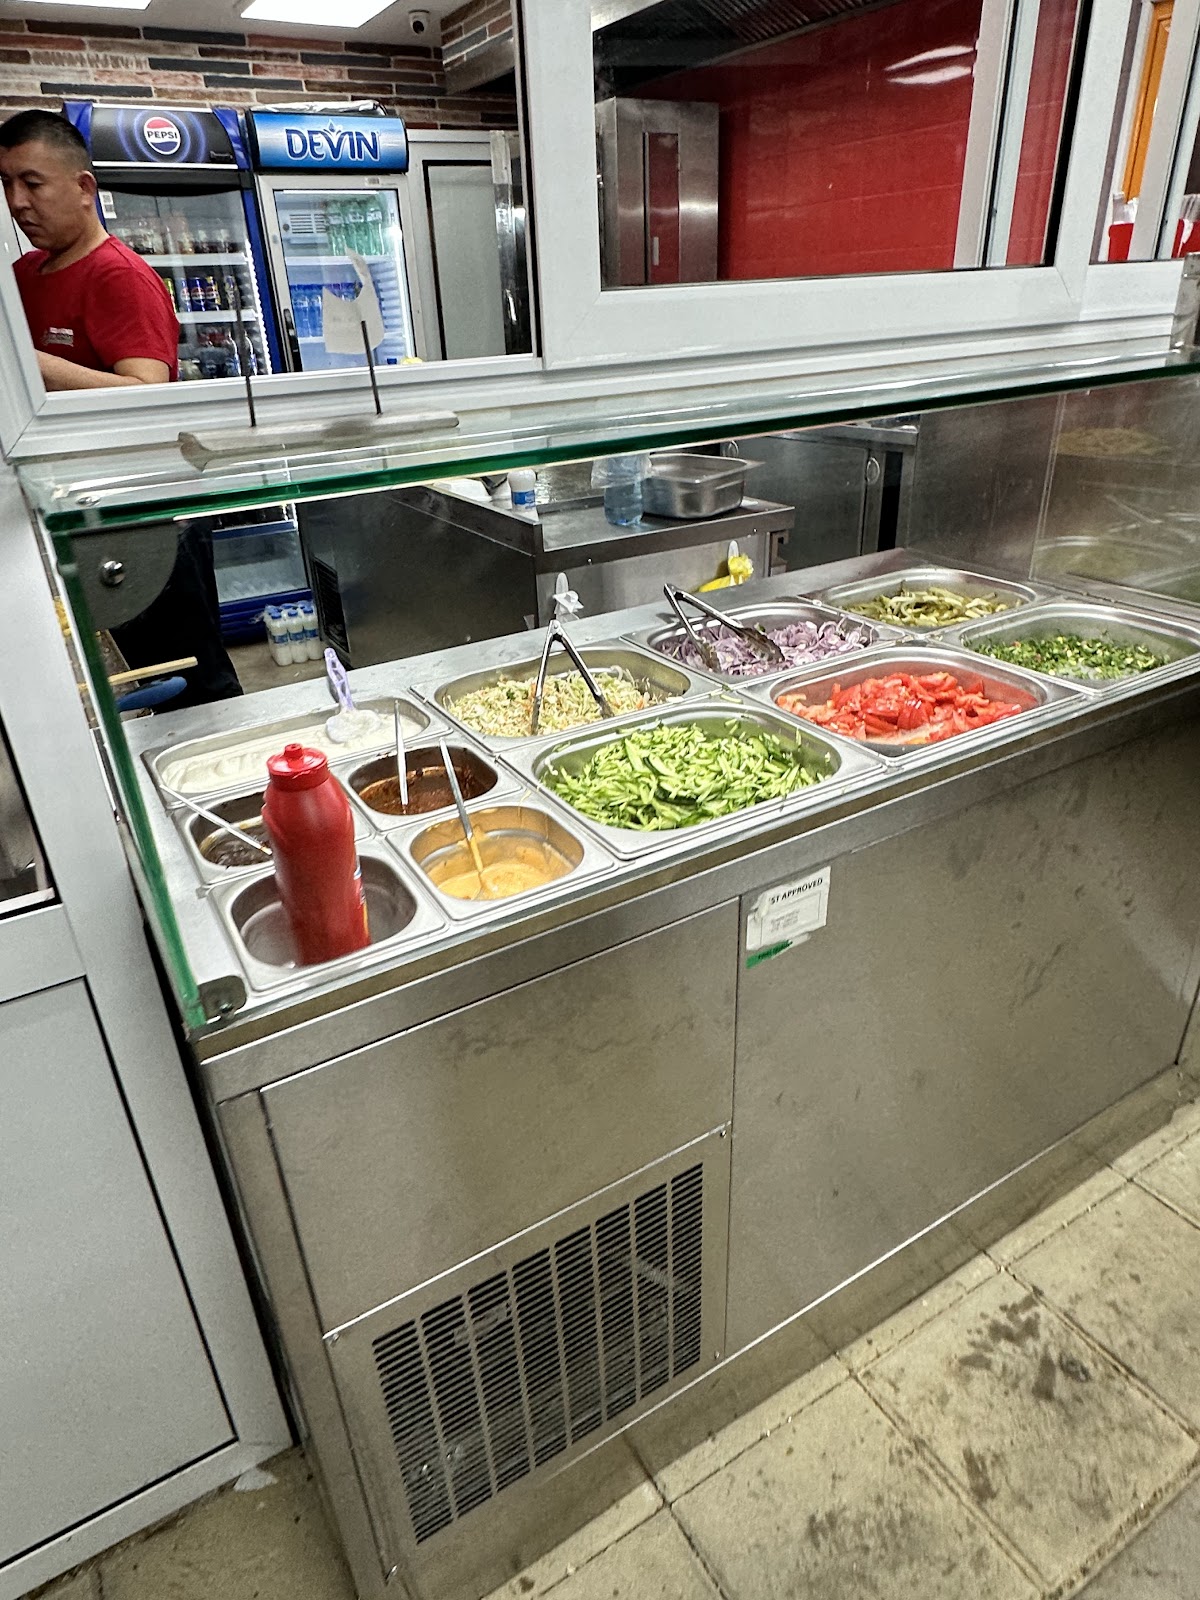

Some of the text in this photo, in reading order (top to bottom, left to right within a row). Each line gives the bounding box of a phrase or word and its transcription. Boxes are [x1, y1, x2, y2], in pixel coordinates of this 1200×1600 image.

[146, 130, 178, 139] PEPSI
[285, 127, 378, 160] DEVIN
[781, 877, 823, 900] APPROVED
